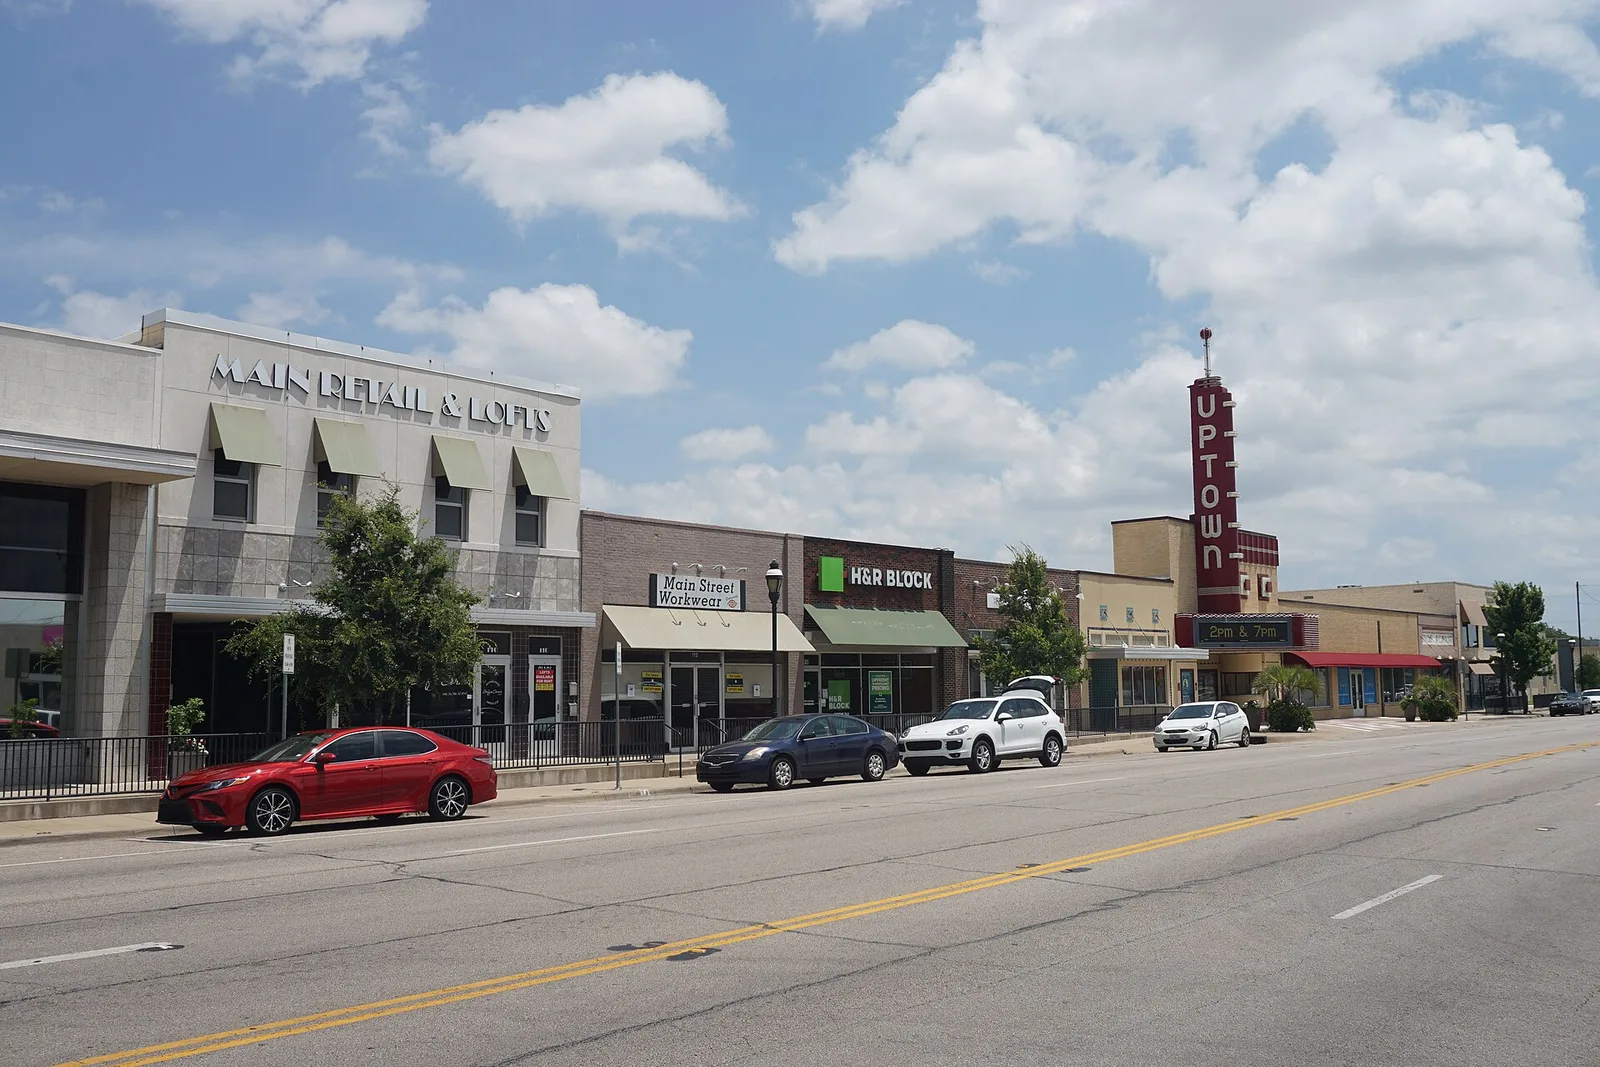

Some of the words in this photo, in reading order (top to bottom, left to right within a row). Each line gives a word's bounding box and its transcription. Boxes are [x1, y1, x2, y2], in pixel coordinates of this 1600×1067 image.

[210, 353, 311, 395] MAIN
[320, 371, 434, 414] RETAIL
[441, 392, 462, 418] &
[469, 396, 551, 432] LOFTS
[663, 576, 696, 591] Main
[699, 578, 734, 594] Street
[851, 566, 882, 586] H&R
[886, 569, 932, 589] BLOCK
[659, 590, 722, 608] Workwear
[1239, 625, 1248, 638] &
[828, 695, 843, 703] H&R
[828, 702, 850, 710] BLOCK
